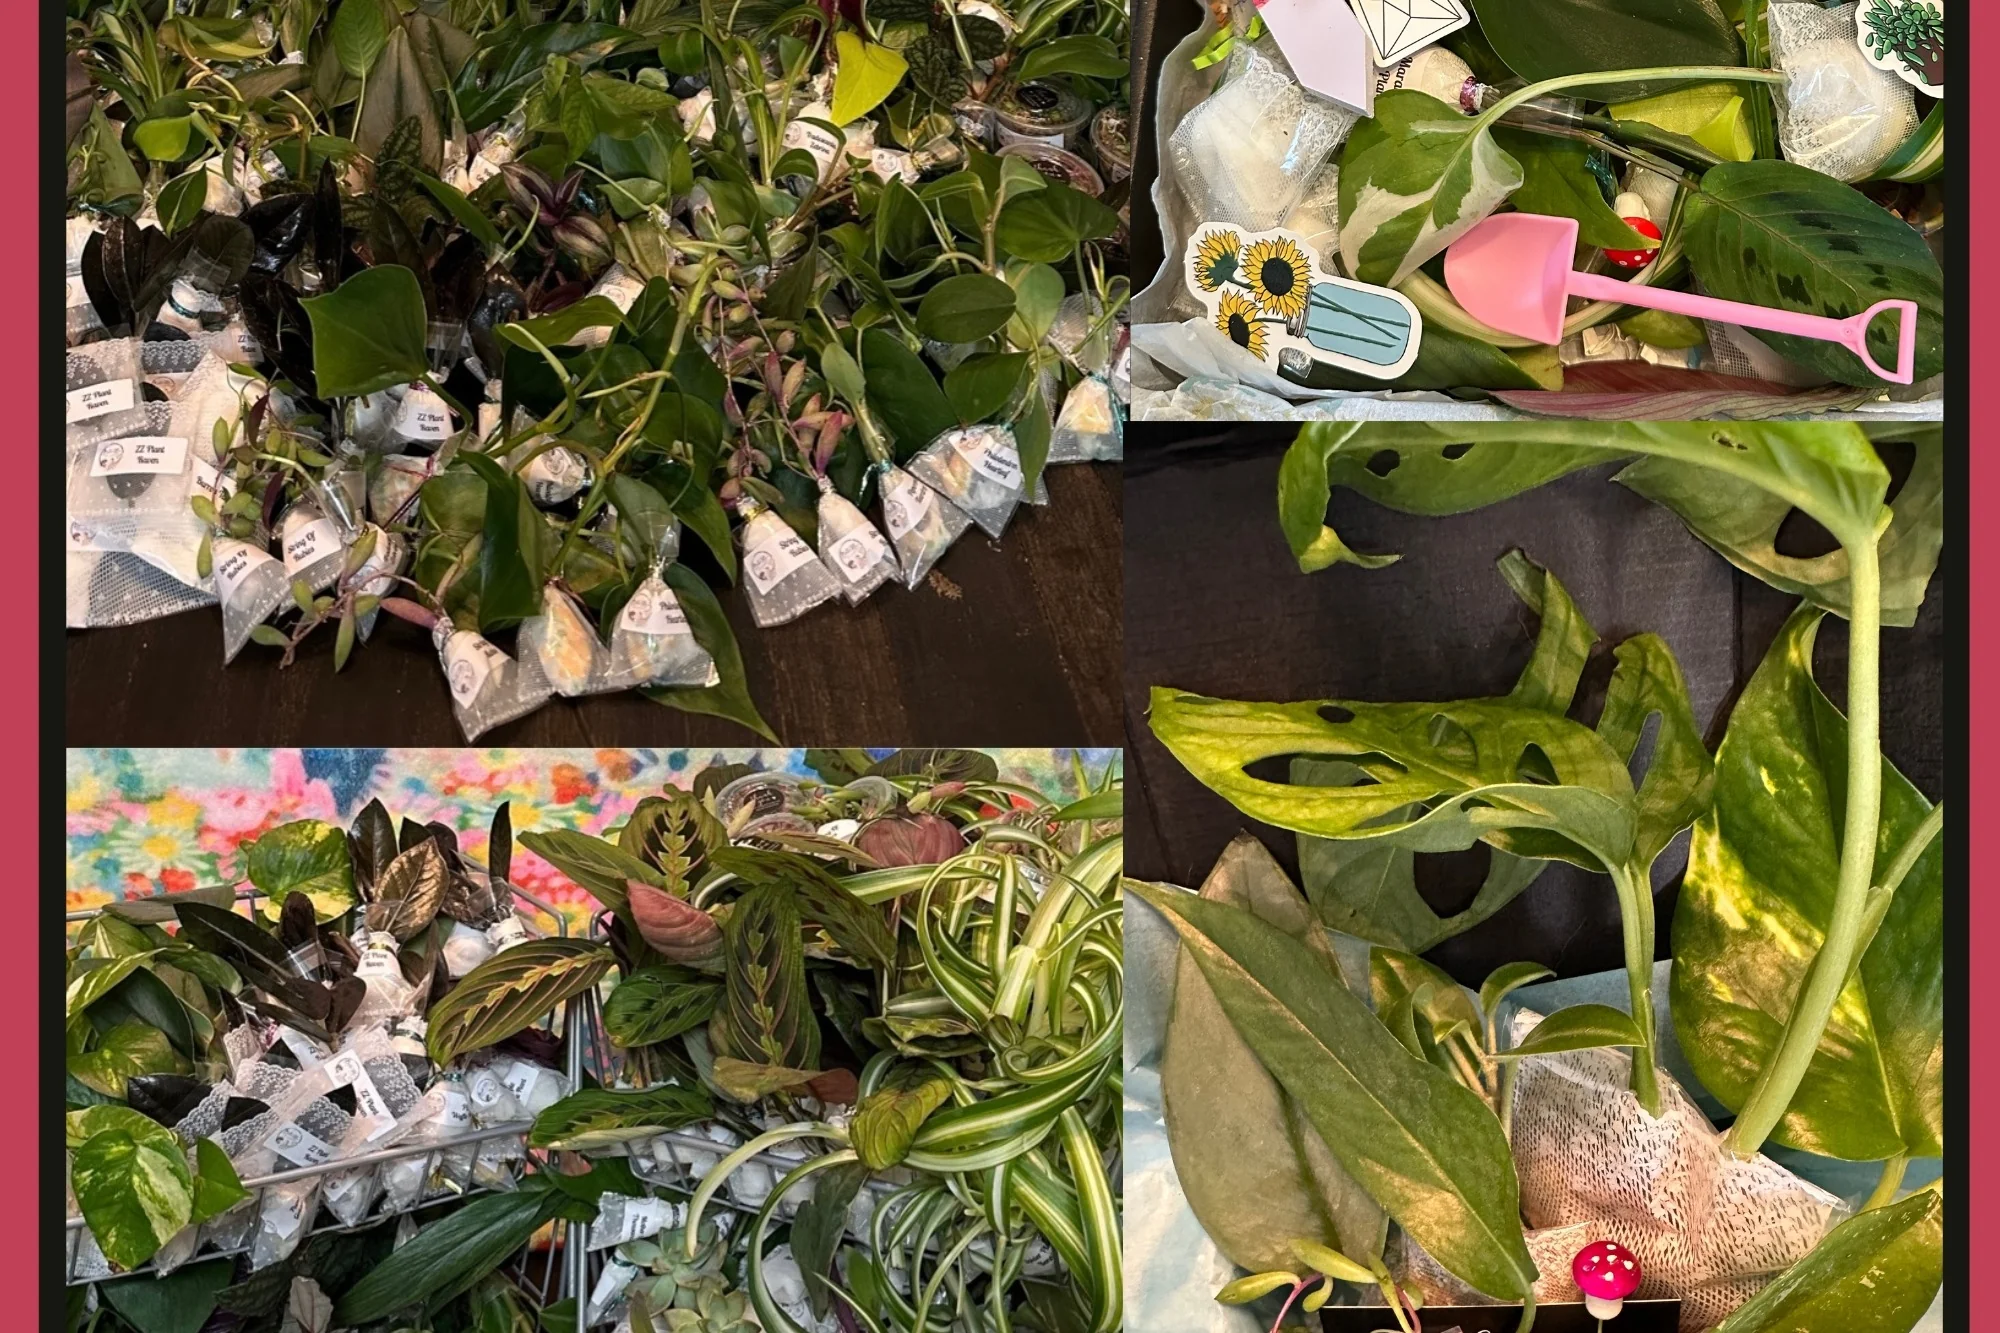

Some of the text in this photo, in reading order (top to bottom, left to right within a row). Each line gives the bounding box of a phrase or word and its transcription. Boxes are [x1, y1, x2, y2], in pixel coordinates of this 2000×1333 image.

[1394, 57, 1413, 89] Mara
[1376, 71, 1391, 95] Pla
[82, 389, 112, 402] ZZ Plant
[86, 400, 109, 410] Raven
[417, 413, 445, 422] ZZ Plant
[420, 424, 440, 432] Raven
[135, 445, 165, 454] ZZ Plant
[137, 456, 159, 464] Raven
[360, 1089, 379, 1115] ZZ Plant
